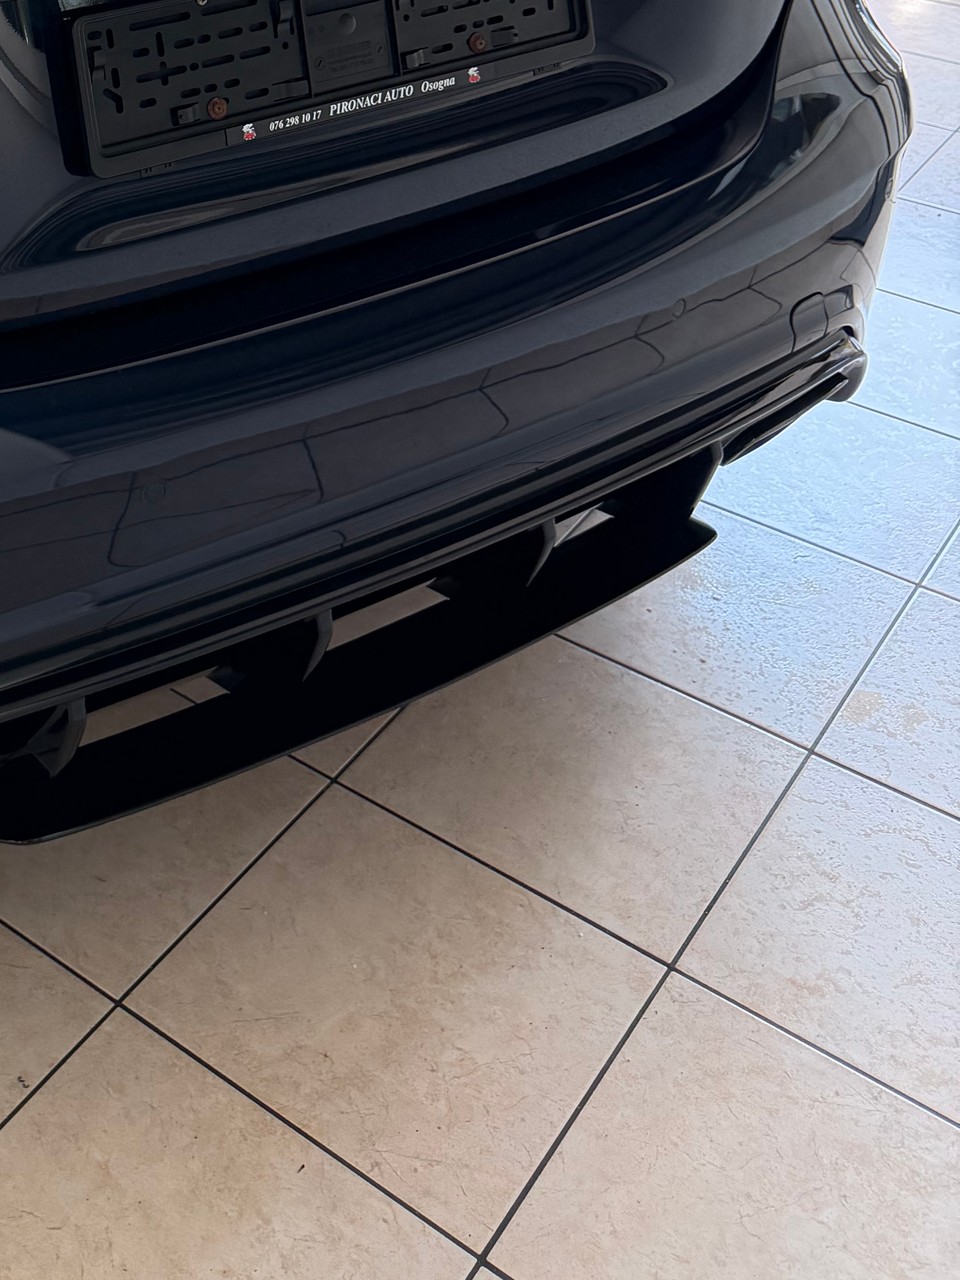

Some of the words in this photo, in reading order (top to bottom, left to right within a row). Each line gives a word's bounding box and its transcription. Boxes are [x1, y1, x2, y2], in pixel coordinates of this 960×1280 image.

[269, 119, 284, 131] 076
[285, 115, 300, 128] 298
[301, 112, 311, 124] 10
[312, 109, 322, 121] 17
[329, 92, 383, 116] PIRONACI
[383, 84, 414, 103] AUTO
[421, 76, 456, 94] Osogna
